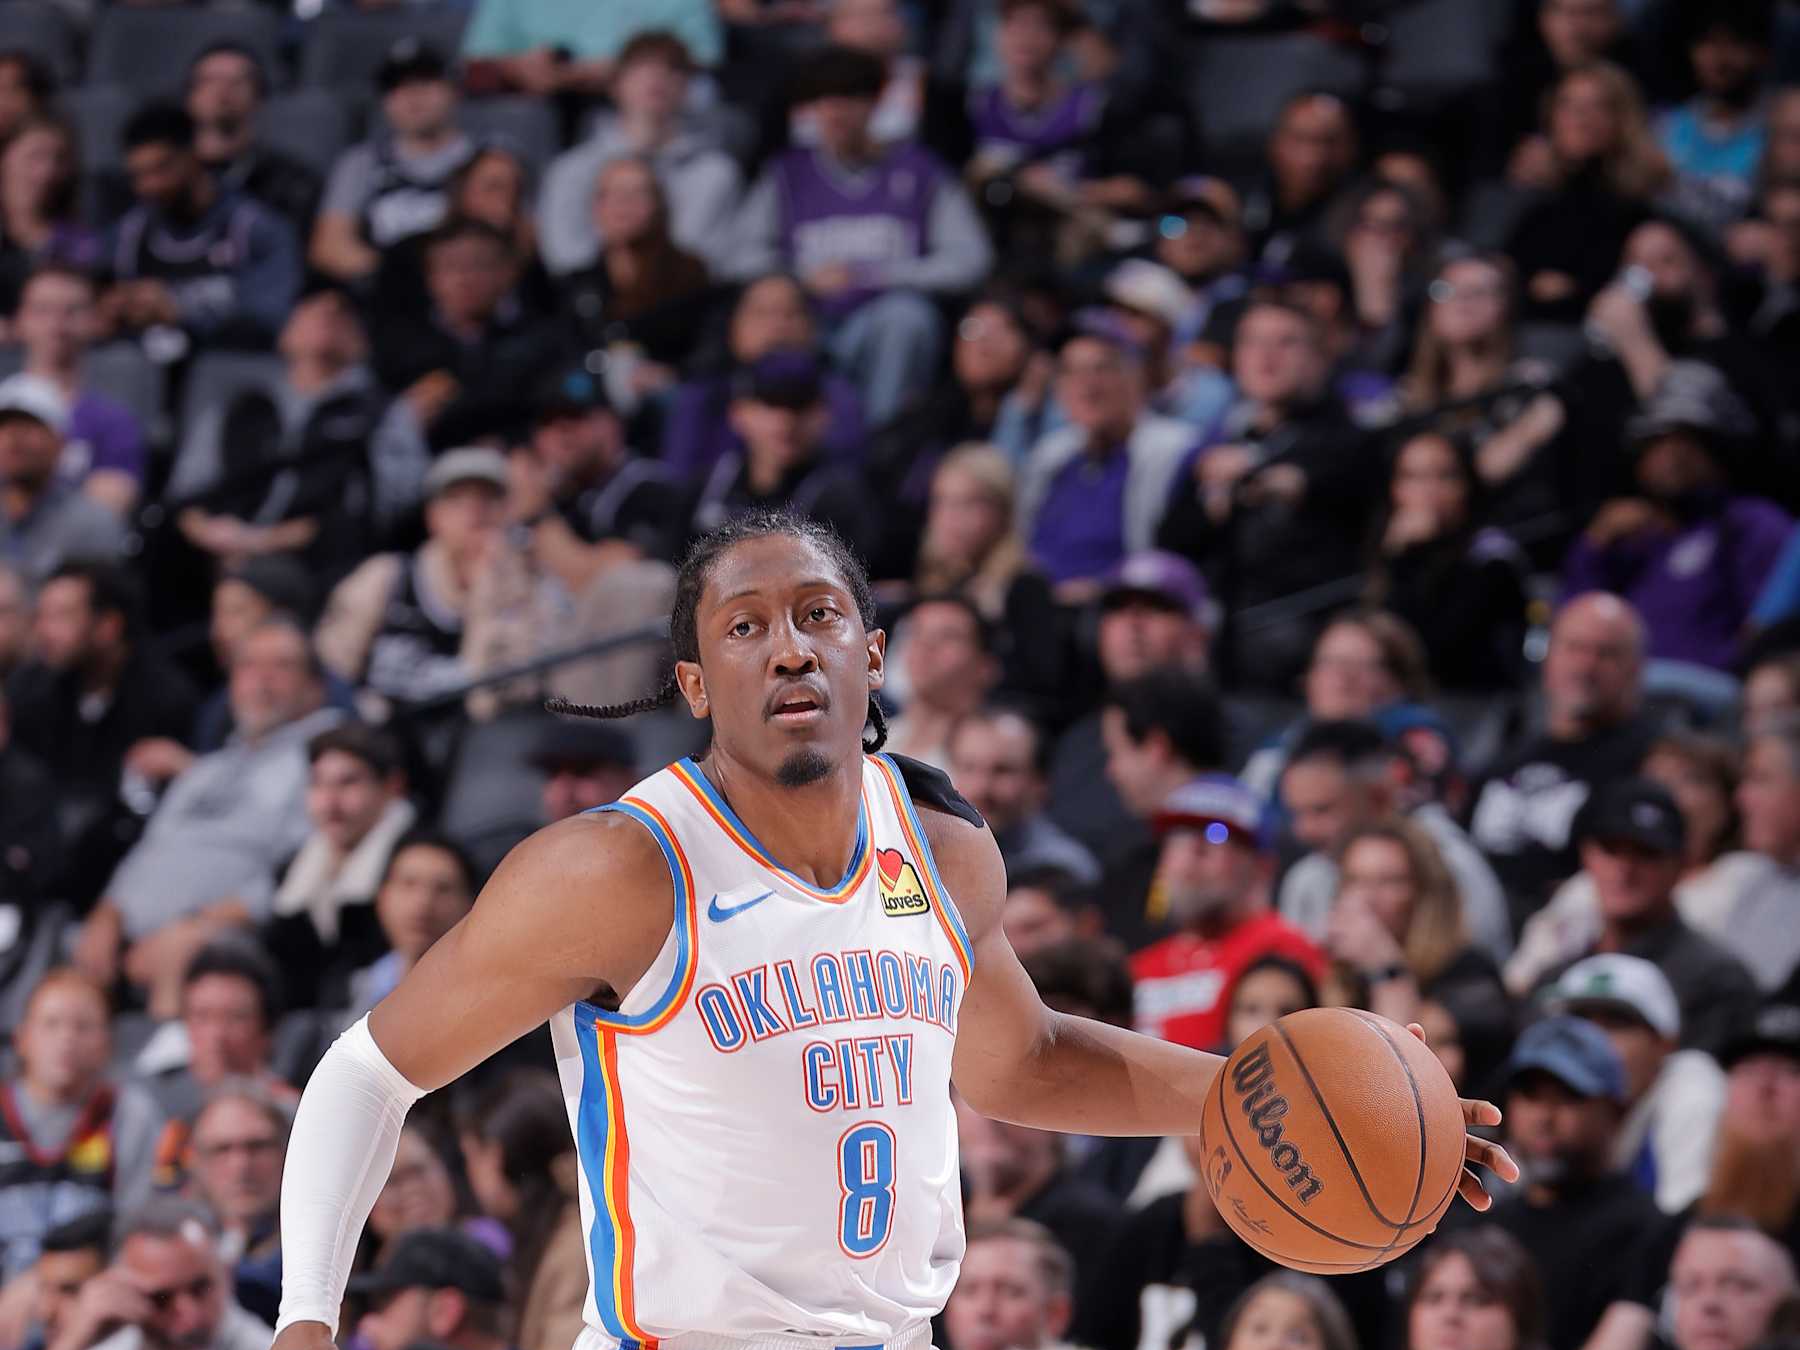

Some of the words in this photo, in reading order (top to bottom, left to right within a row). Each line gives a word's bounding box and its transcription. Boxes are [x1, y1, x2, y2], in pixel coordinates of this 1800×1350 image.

[695, 949, 957, 1054] OKLAHOMA
[802, 1033, 914, 1114] CITY
[1231, 1040, 1325, 1208] Wilson
[837, 1119, 897, 1261] 8
